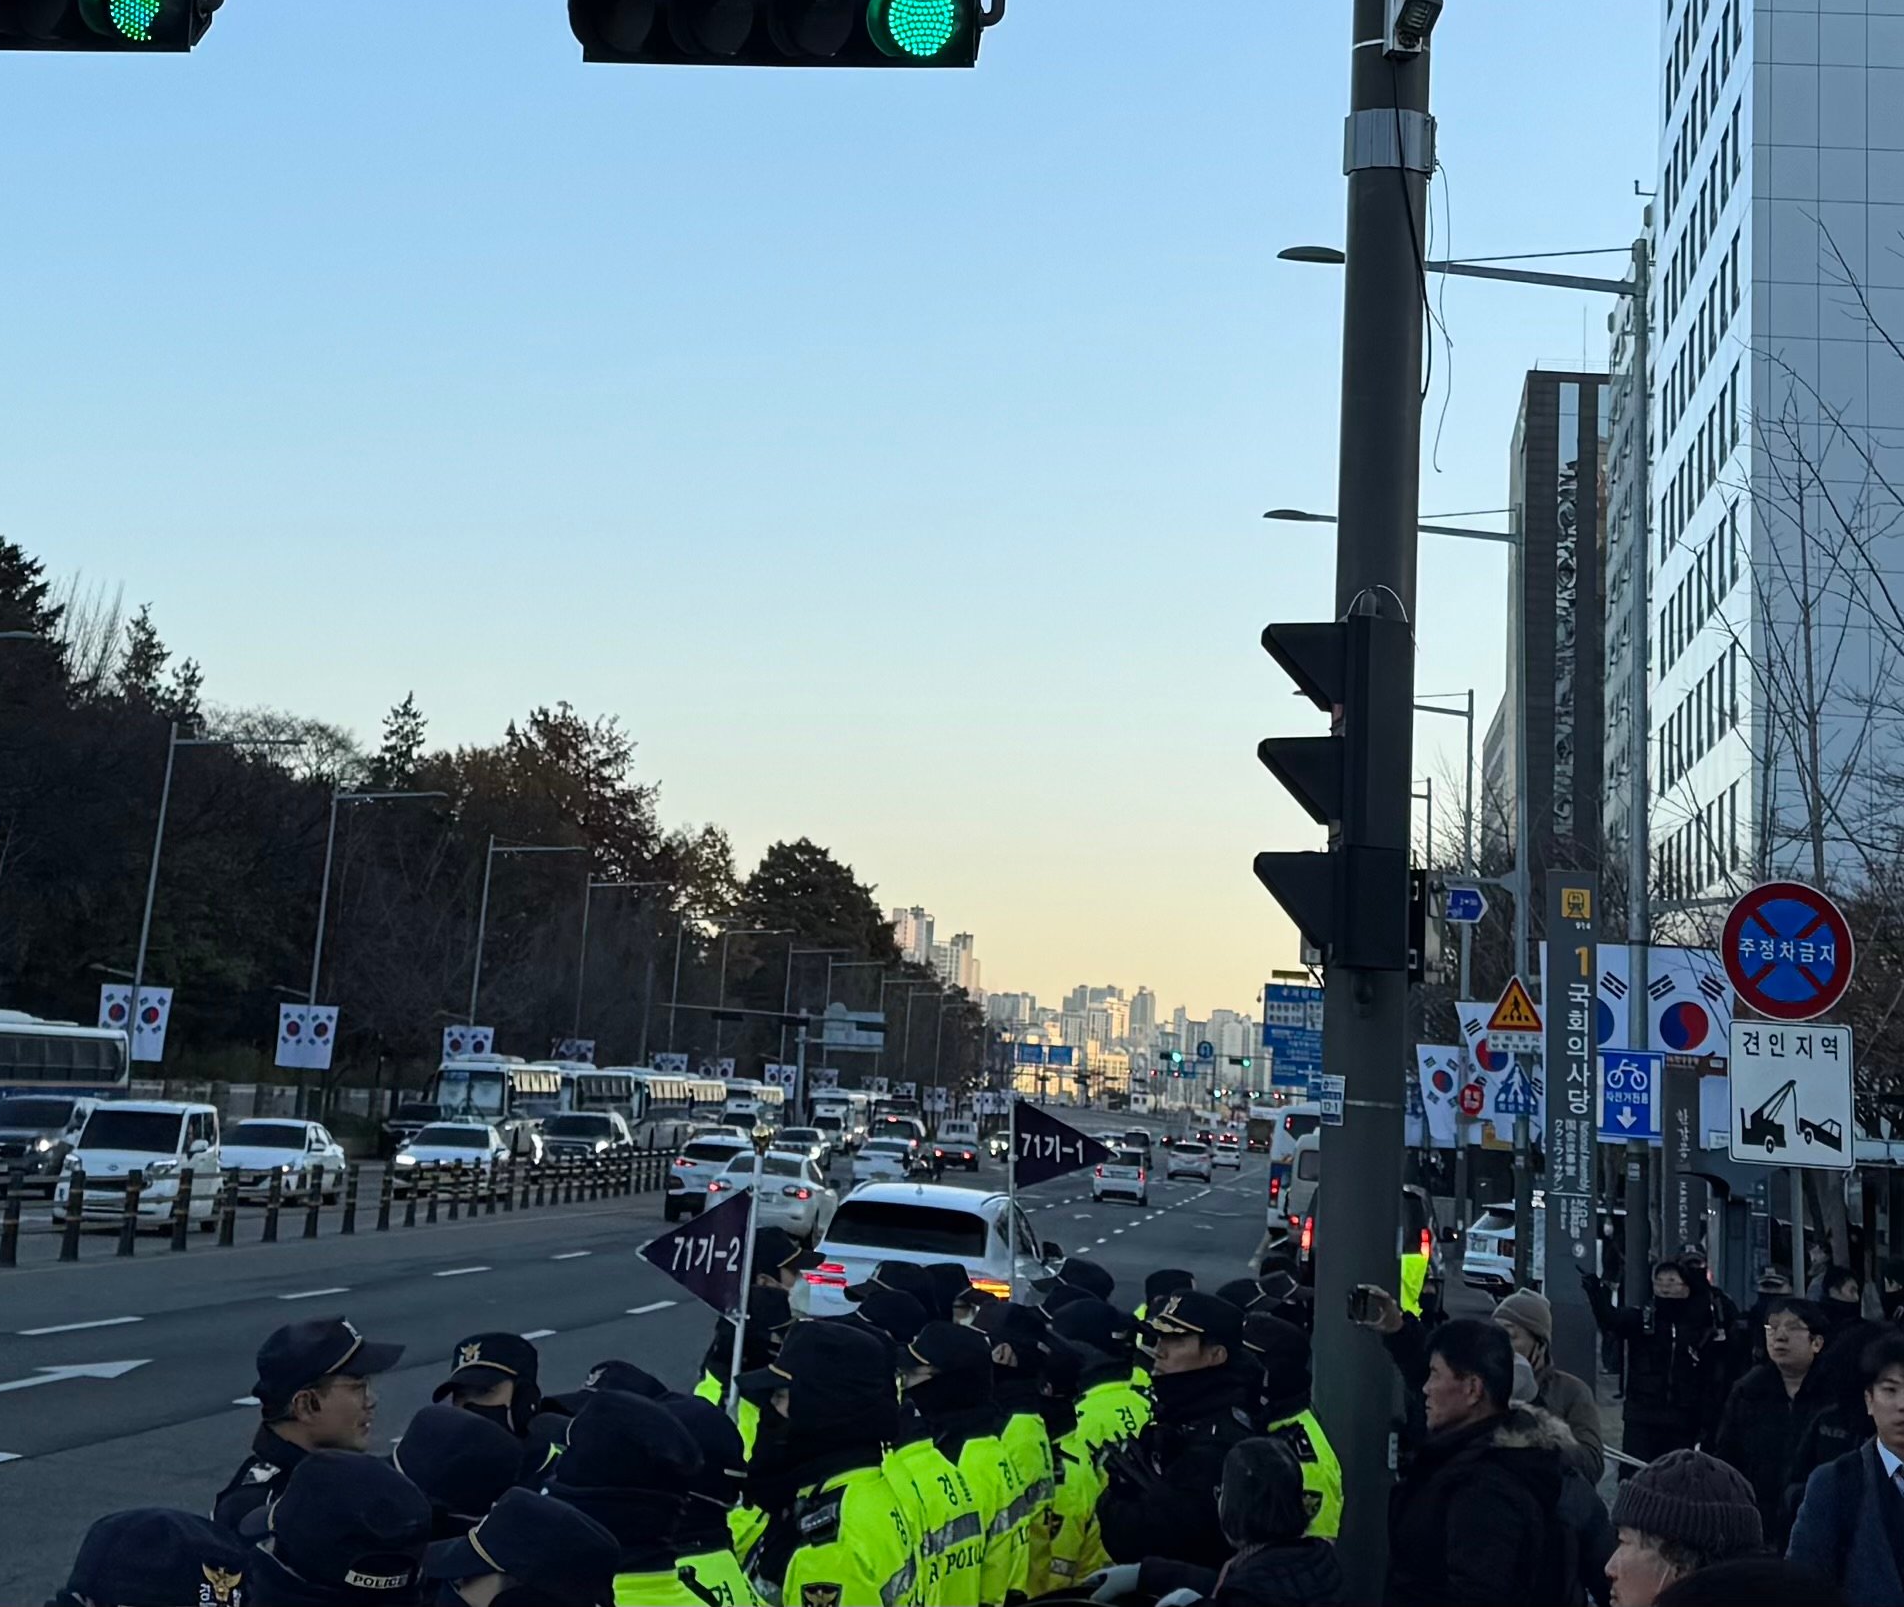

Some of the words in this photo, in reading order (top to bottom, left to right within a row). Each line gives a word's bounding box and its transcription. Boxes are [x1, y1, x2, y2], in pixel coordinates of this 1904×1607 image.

[1574, 945, 1589, 977] 1
[1739, 937, 1835, 966] 주정차금지
[1566, 982, 1592, 1115] 국회의사당
[1742, 1030, 1839, 1061] 견인지역
[1020, 1132, 1084, 1165] 71기-1
[671, 1233, 741, 1274] 71기-2
[352, 1573, 407, 1589] POLICE
